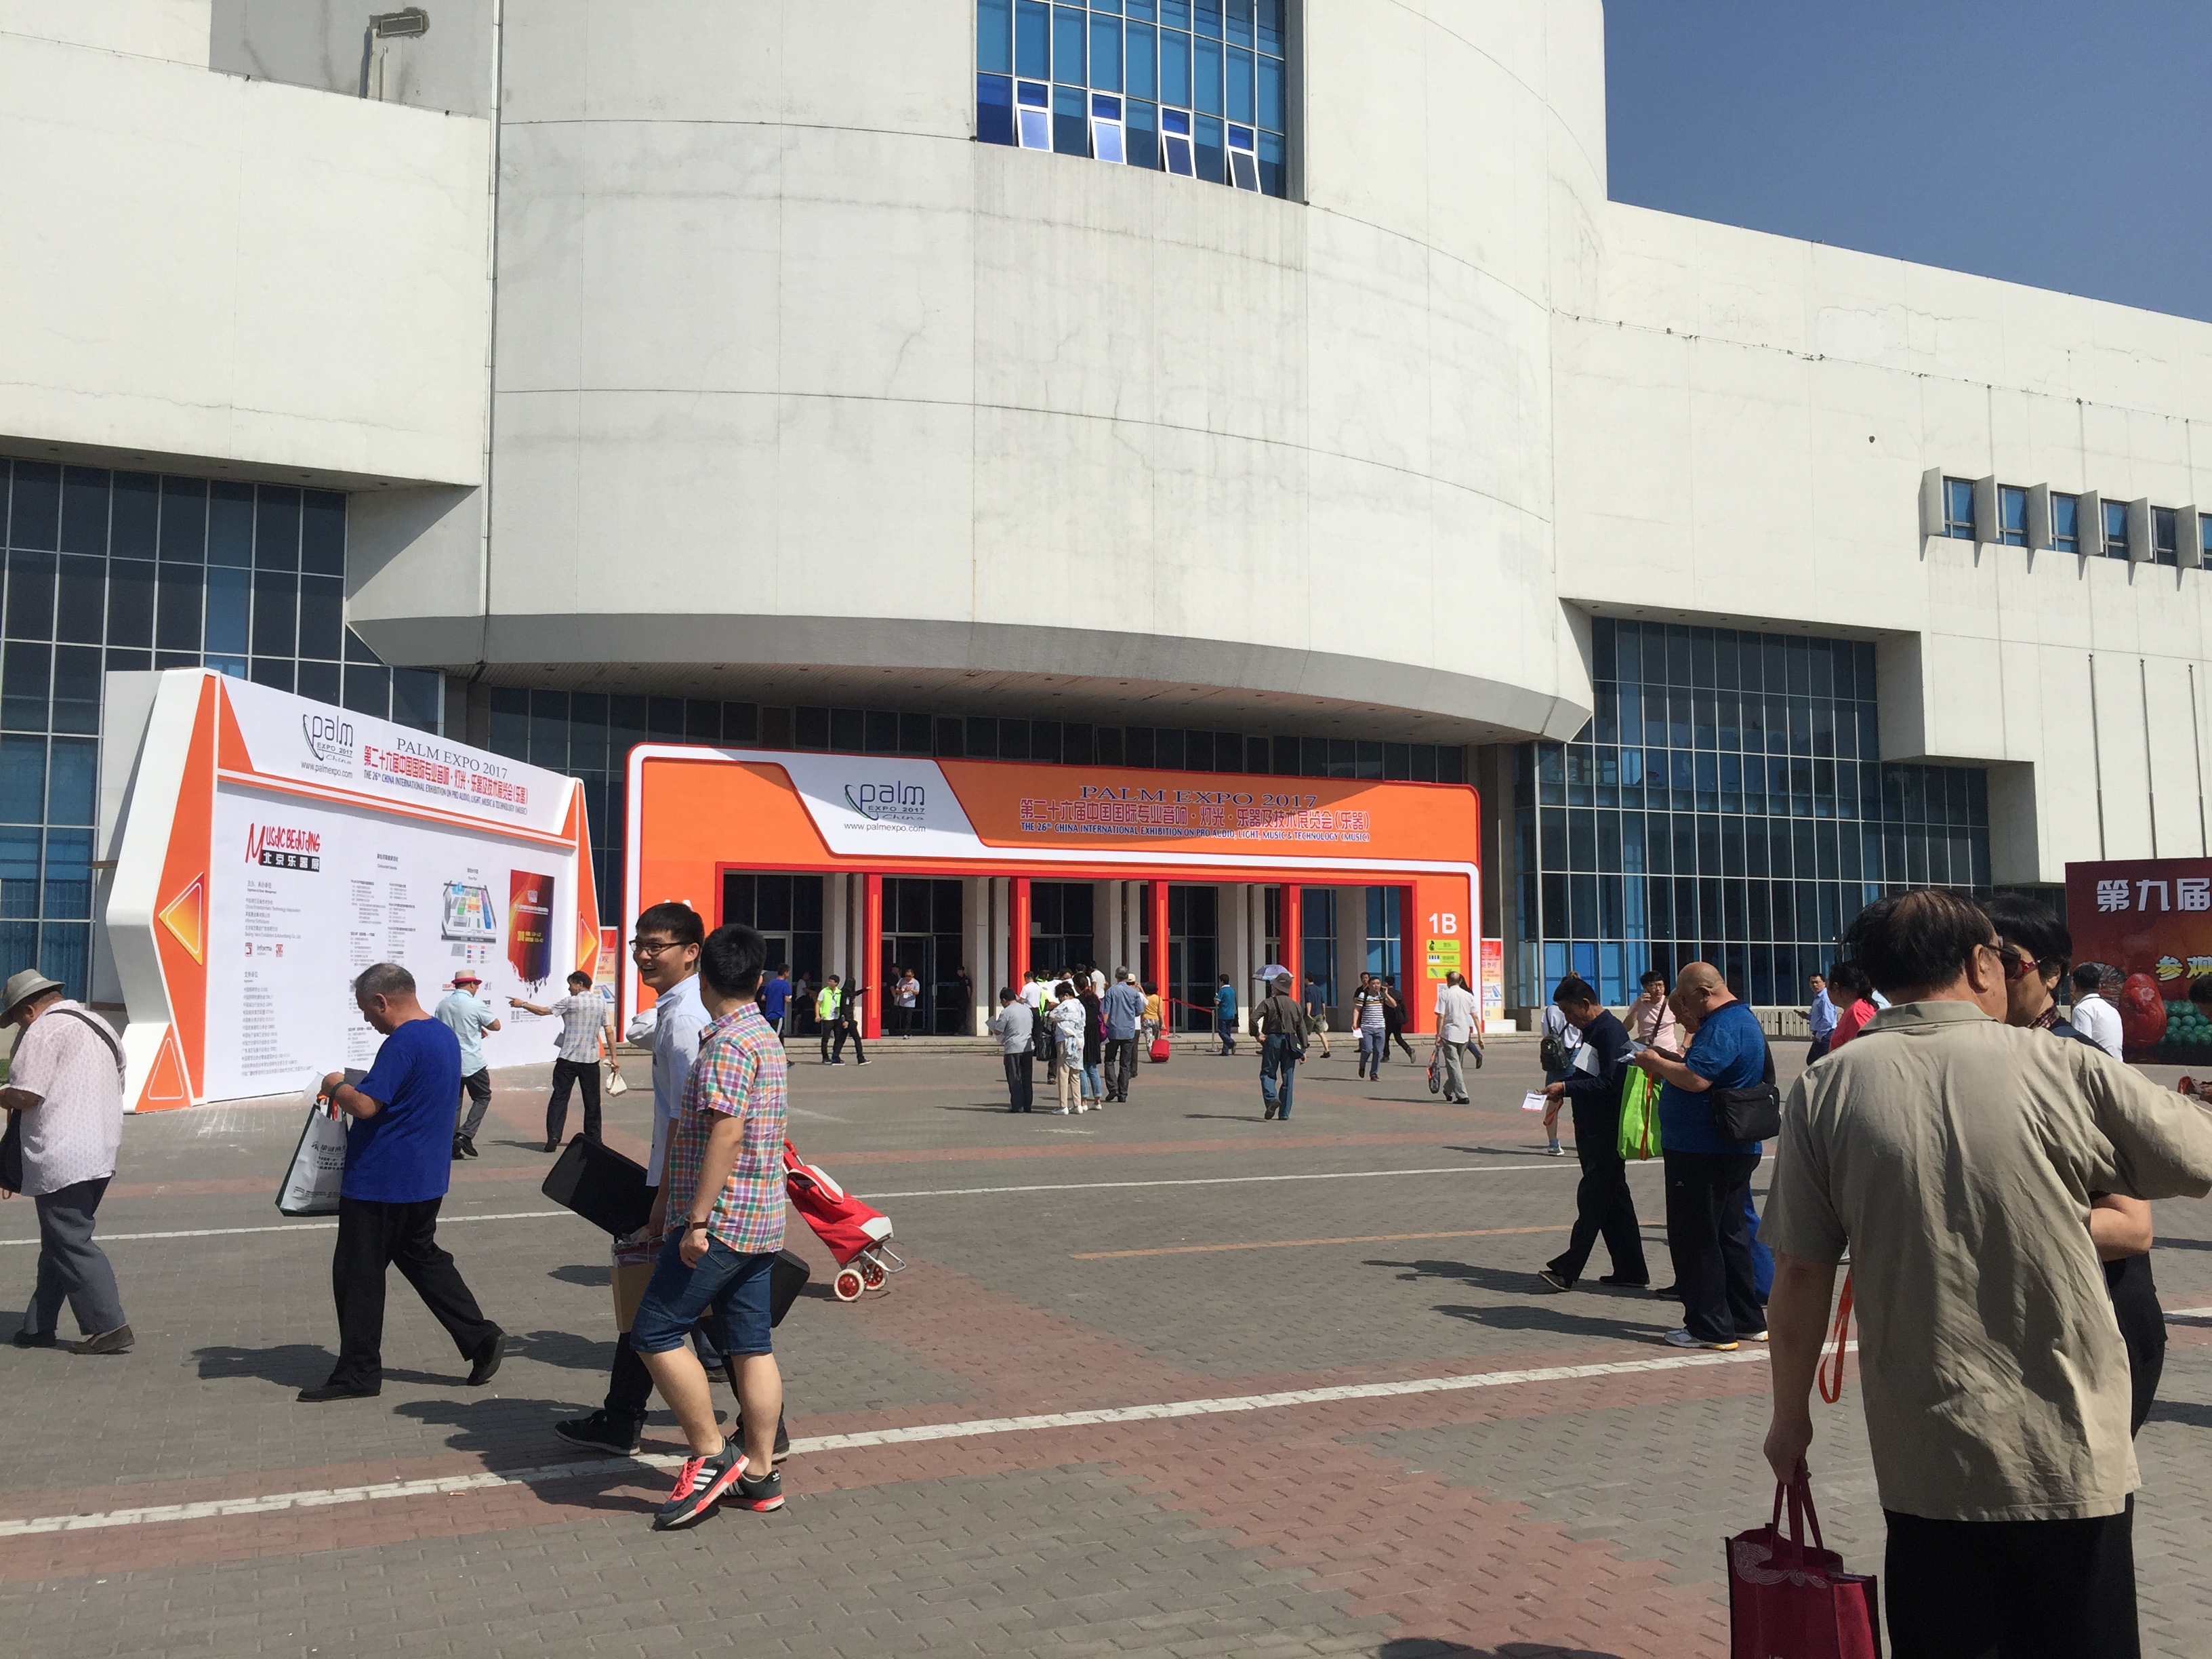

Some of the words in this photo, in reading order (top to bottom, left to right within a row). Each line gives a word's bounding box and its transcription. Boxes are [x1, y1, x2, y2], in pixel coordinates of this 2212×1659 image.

[312, 715, 353, 747] palm
[317, 742, 335, 752] EXPO
[339, 747, 353, 756] 2017
[326, 754, 352, 765] China
[396, 737, 440, 761] PALM
[443, 750, 480, 772] EXPO
[483, 762, 508, 779] 2017
[301, 762, 353, 779] www.palmexpo.com
[382, 773, 394, 785] CHINA
[395, 776, 425, 792] INTERNATIONAL
[426, 783, 447, 796] EXHIBITION
[495, 800, 514, 813] TECHNOLOGY
[860, 780, 925, 811] palm
[1079, 785, 1167, 803] PALM
[1174, 790, 1254, 806] EXPO
[1261, 794, 1317, 808] 2017
[844, 823, 926, 833] www.palmexpo.com
[1021, 822, 1035, 832] THE
[1054, 823, 1079, 833] CHINA
[1080, 824, 1139, 835] INTERNATIONAL
[1141, 826, 1183, 837] EXHIBITION
[1183, 827, 1194, 838] ON
[1196, 828, 1210, 838] PRO
[1212, 829, 1237, 840] AUDIO,
[1238, 830, 1261, 840] LIGHT,
[1263, 831, 1285, 840] MUSIC
[1287, 832, 1292, 840] &
[1294, 832, 1339, 841] TECHNOLOGY
[1340, 832, 1370, 842] (MUSIC)
[262, 852, 319, 870] 北京乐器展
[2096, 878, 2211, 913] 第九届
[1429, 912, 1457, 935] 1B
